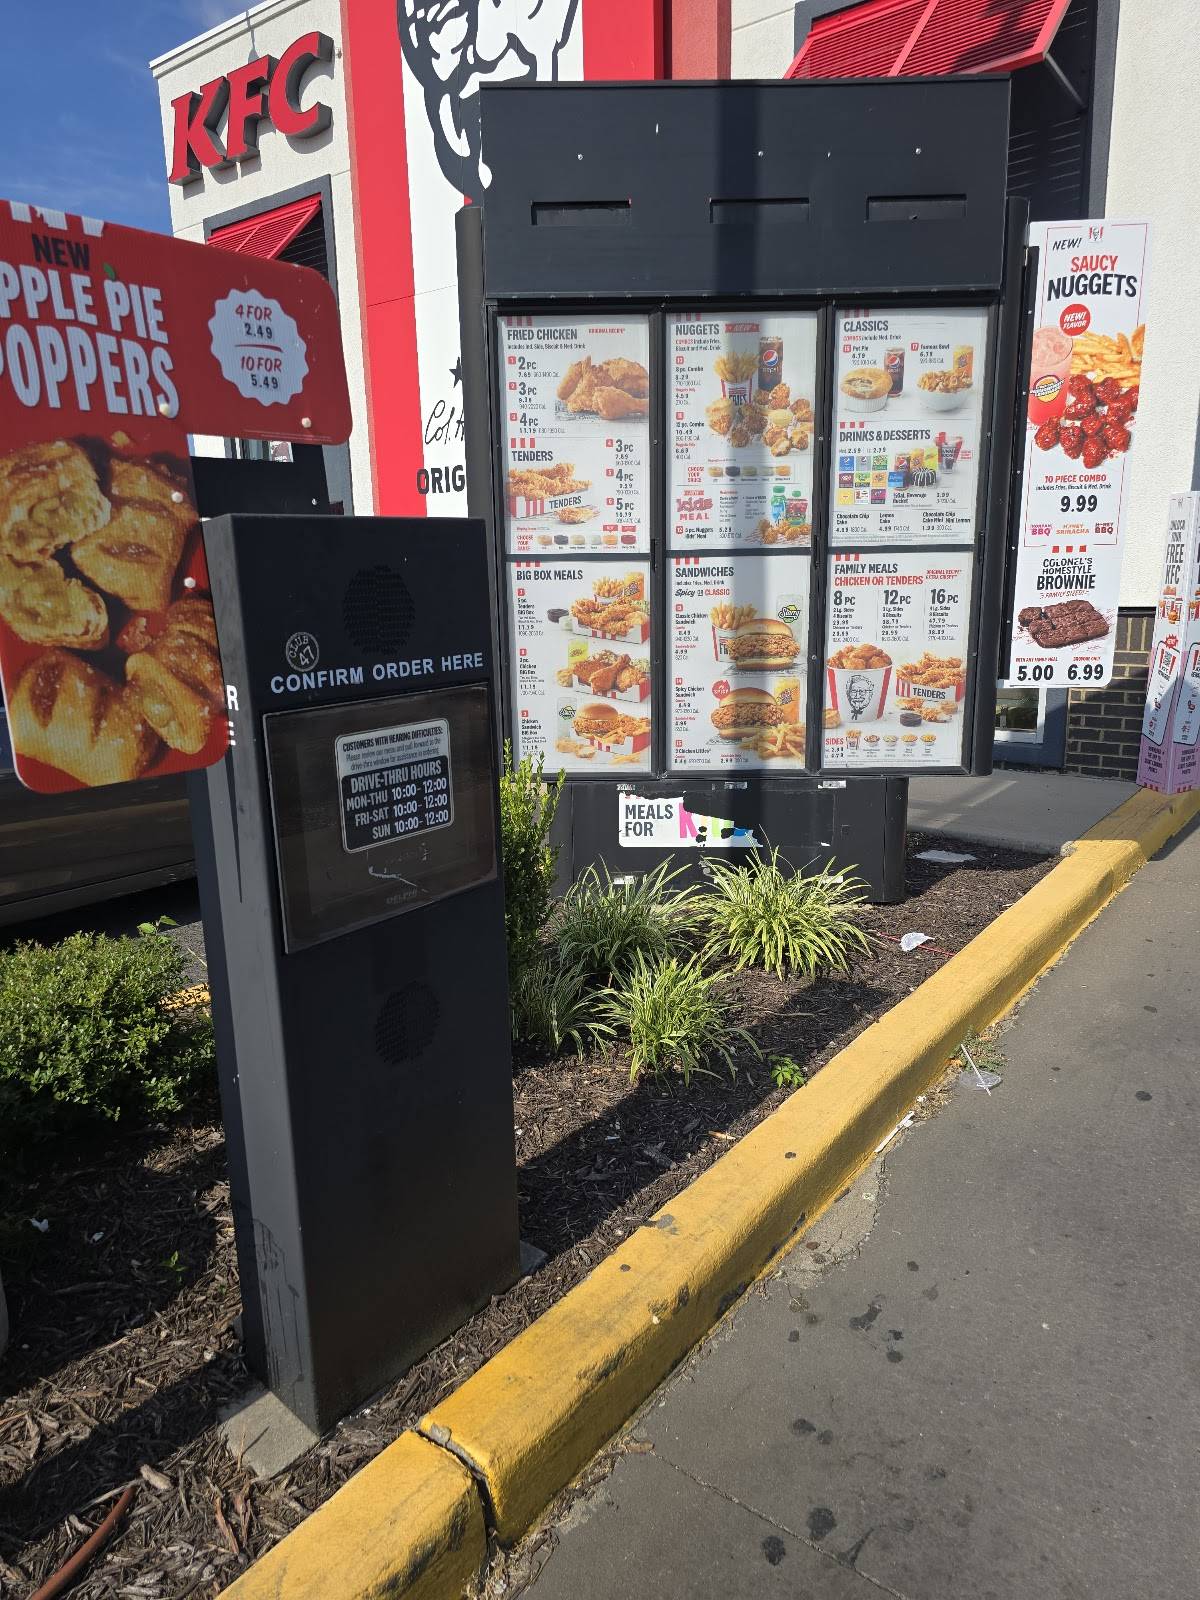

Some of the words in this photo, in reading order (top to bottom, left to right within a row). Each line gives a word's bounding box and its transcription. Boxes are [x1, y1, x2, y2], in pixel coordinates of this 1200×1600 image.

[169, 31, 334, 184] KFC
[1052, 237, 1082, 251] NEW!
[31, 233, 91, 272] NEW
[1071, 255, 1118, 273] SAUCY
[1047, 273, 1138, 301] NUGGETS
[103, 278, 170, 344] PIE
[235, 304, 244, 319] 4
[246, 305, 272, 321] FOR
[1064, 311, 1086, 322] NEW!
[244, 322, 273, 339] 2.49
[675, 324, 720, 336] NUGGETS
[844, 320, 889, 332] CLASSICS
[507, 329, 535, 341] FRIED
[536, 329, 578, 340] CHICKEN
[0, 322, 180, 419] OPPERS
[240, 355, 255, 371] 10
[257, 357, 282, 372] FOR
[518, 356, 526, 370] 2
[526, 361, 537, 370] PC
[250, 374, 279, 389] 5.49
[519, 381, 526, 395] 3
[527, 387, 537, 396] PC
[520, 413, 527, 427] 4
[528, 418, 538, 427] PC
[839, 430, 875, 442] DRINKS
[875, 431, 882, 441] &
[883, 429, 931, 441] DESSERTS
[615, 439, 623, 452] 3
[624, 444, 634, 452] PC
[512, 451, 553, 461] TENDERS
[416, 464, 466, 495] ORIG
[615, 469, 623, 481] 4
[624, 473, 634, 482] PC
[1045, 475, 1053, 484] 10
[1055, 475, 1077, 483] PIECE
[1079, 474, 1107, 483] COMBO
[549, 496, 582, 510] TENDERS
[616, 498, 623, 511] 5
[625, 502, 634, 511] PC
[1060, 495, 1098, 512] 9.99
[679, 513, 710, 521] MEAL
[1031, 528, 1051, 536] BBQ
[1166, 544, 1185, 563] FREE
[834, 564, 867, 574] FAMILY
[868, 563, 898, 574] MEALS
[1042, 565, 1092, 575] HOMESTYLE
[1043, 557, 1093, 568] COLONEL'S
[516, 570, 532, 580] BIG
[533, 570, 552, 580] BOX
[553, 569, 583, 580] MEALS
[675, 566, 734, 578] SANDWICHES
[1165, 565, 1181, 584] KFC
[834, 576, 867, 587] CHICKEN
[868, 576, 886, 586] OR
[886, 575, 924, 586] TENDERS
[1036, 574, 1096, 590] BROWNIE
[674, 588, 696, 598] Spicy
[704, 588, 731, 596] CLASSIC
[833, 590, 843, 606] 8
[844, 596, 856, 606] PC
[883, 589, 899, 605] 12
[899, 595, 911, 605] PC
[930, 588, 946, 604] 16
[947, 594, 959, 604] PC
[288, 635, 310, 659] CLUB
[298, 645, 316, 667] 47
[270, 667, 364, 694] CONFIRM
[372, 657, 434, 681] ORDER
[441, 652, 484, 671] HERE
[1017, 665, 1054, 681] 5.00
[1067, 664, 1104, 680] 6.99
[912, 687, 946, 700] TENDERS
[343, 738, 375, 752] CUSTOMERS
[375, 735, 389, 747] WITH
[389, 731, 411, 743] HEARING
[411, 726, 443, 740] DIFFICULTIES:
[396, 744, 405, 752] and
[413, 740, 429, 749] forward
[825, 737, 844, 746] SIDES
[373, 757, 390, 767] window
[350, 766, 409, 794] DRIVE-THRU
[410, 759, 442, 780] HOURS
[346, 790, 388, 812] MON-THU
[391, 783, 417, 801] 10:00
[422, 777, 447, 794] 12:00
[354, 806, 390, 828] FRI-SAT
[393, 800, 418, 818] 10:00
[423, 793, 448, 811] 12:00
[625, 804, 674, 820] MEALS
[372, 822, 391, 840] SUN
[394, 816, 419, 834] 10:00
[424, 809, 449, 827] 12:00
[625, 821, 654, 837] FOR
